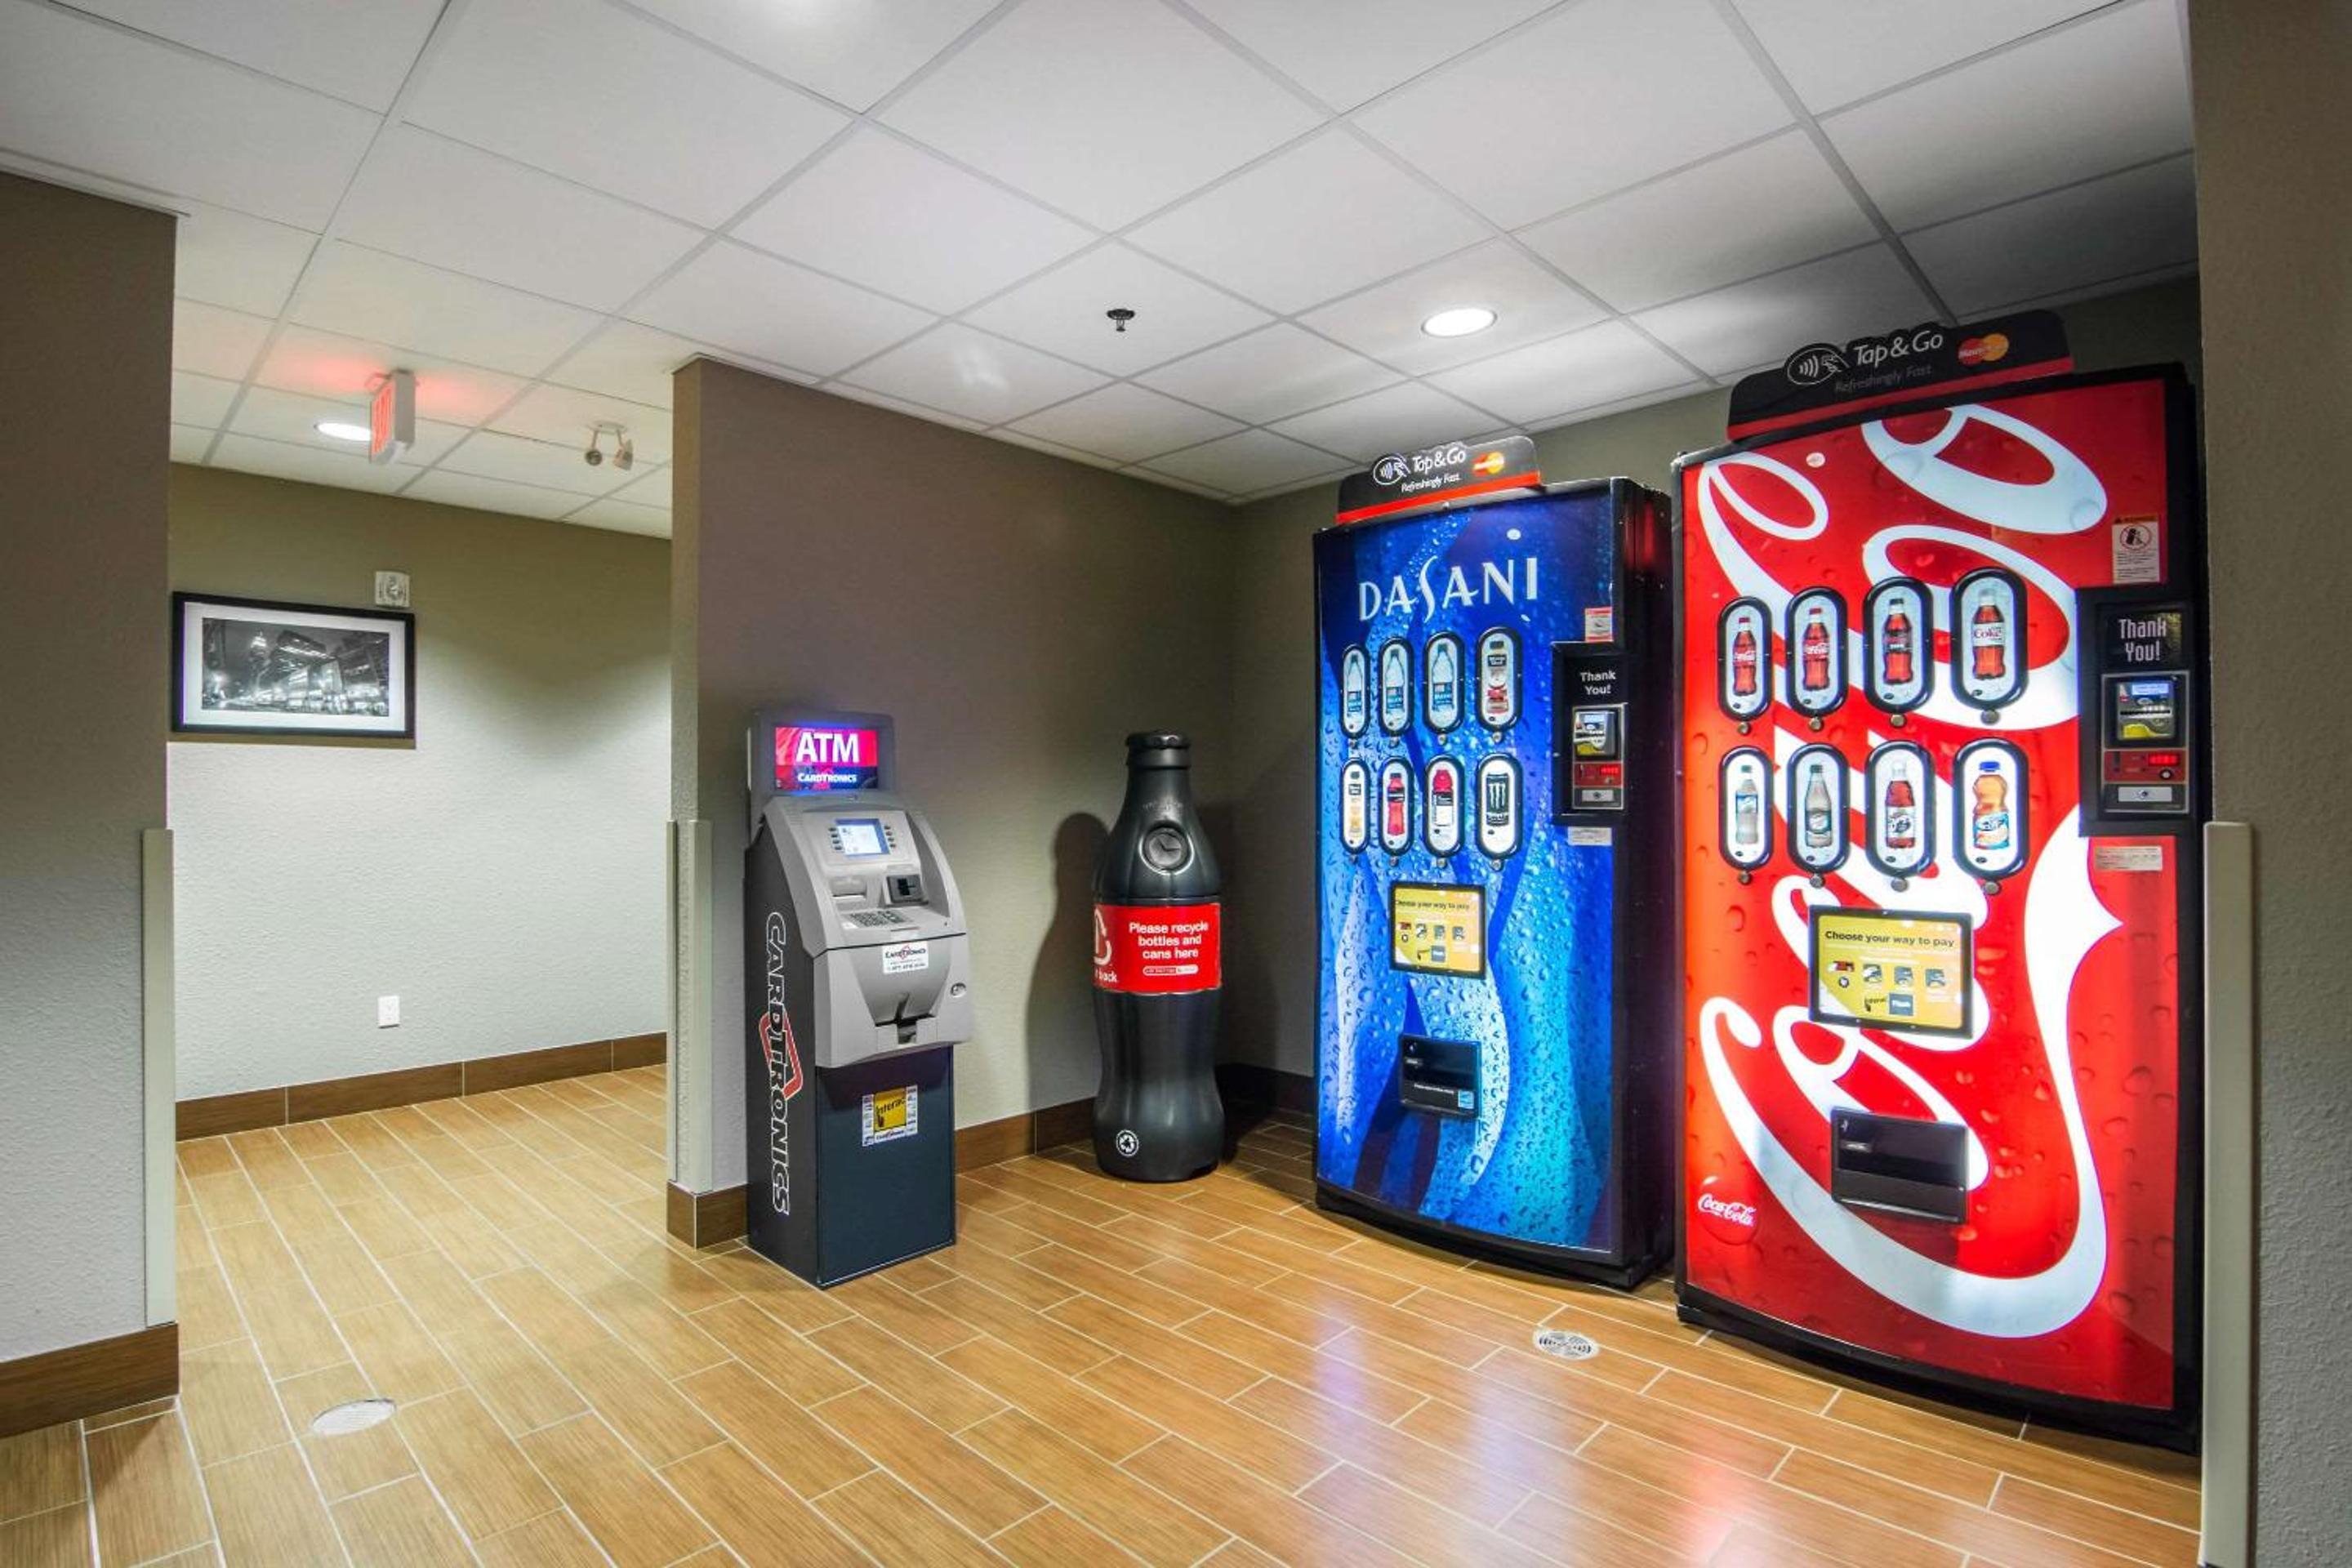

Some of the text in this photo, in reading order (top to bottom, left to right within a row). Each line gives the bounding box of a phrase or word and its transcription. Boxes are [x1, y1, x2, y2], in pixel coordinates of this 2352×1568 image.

[1358, 555, 1538, 624] DASANI
[2118, 617, 2167, 639] Thank
[2125, 641, 2161, 662] You!
[1579, 670, 1616, 683] Thank
[1584, 684, 1611, 695] You!
[795, 732, 859, 763] ATM
[1129, 922, 1209, 934] Please recycle
[1138, 934, 1202, 947] bottles and
[1825, 930, 1954, 947] Choose your way to pay
[1143, 948, 1199, 960] cans here
[766, 911, 790, 1216] CARDTRONICS
